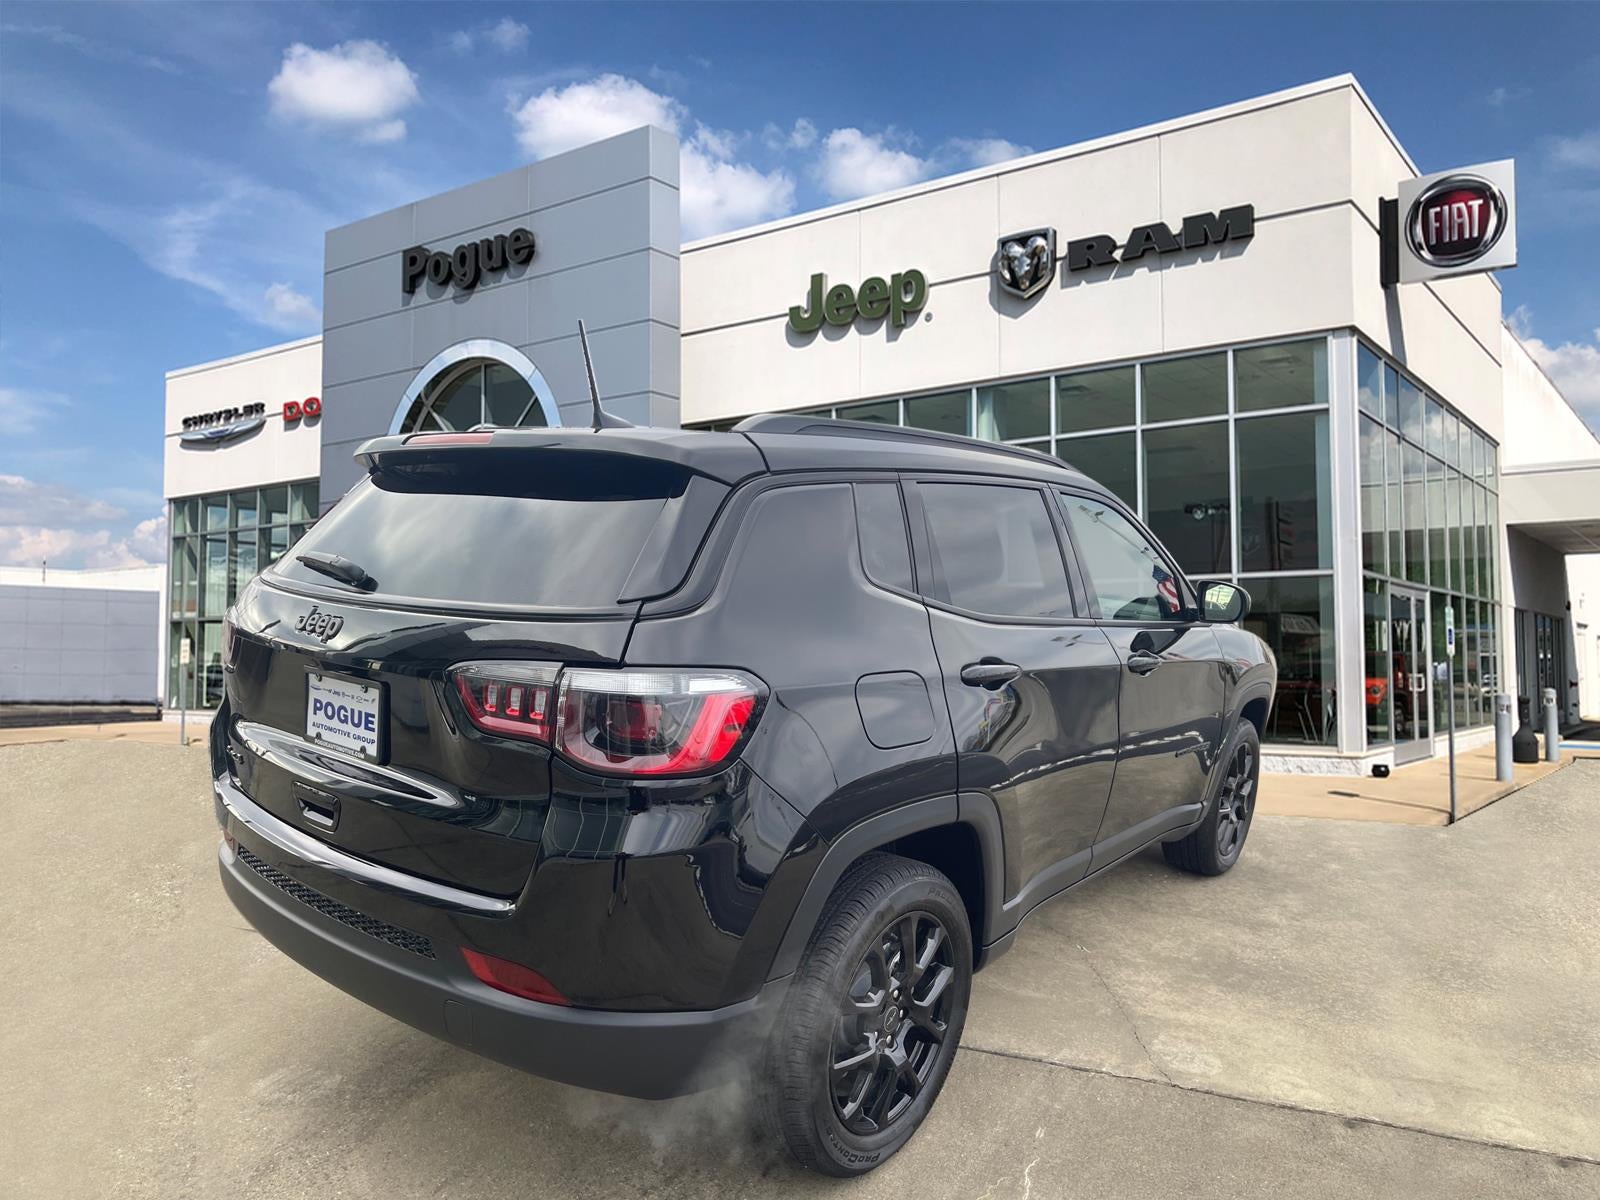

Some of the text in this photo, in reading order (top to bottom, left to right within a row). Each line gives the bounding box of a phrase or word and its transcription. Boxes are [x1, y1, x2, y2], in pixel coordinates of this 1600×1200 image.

[1066, 203, 1255, 271] RAM
[1428, 199, 1484, 246] FIAT
[401, 226, 536, 294] Pogue
[787, 268, 930, 333] Jeep
[181, 401, 266, 428] CHRYSLER
[295, 605, 345, 644] Jeep
[311, 721, 376, 745] AUTOMOTIVE GROUP
[312, 697, 376, 733] POGUE
